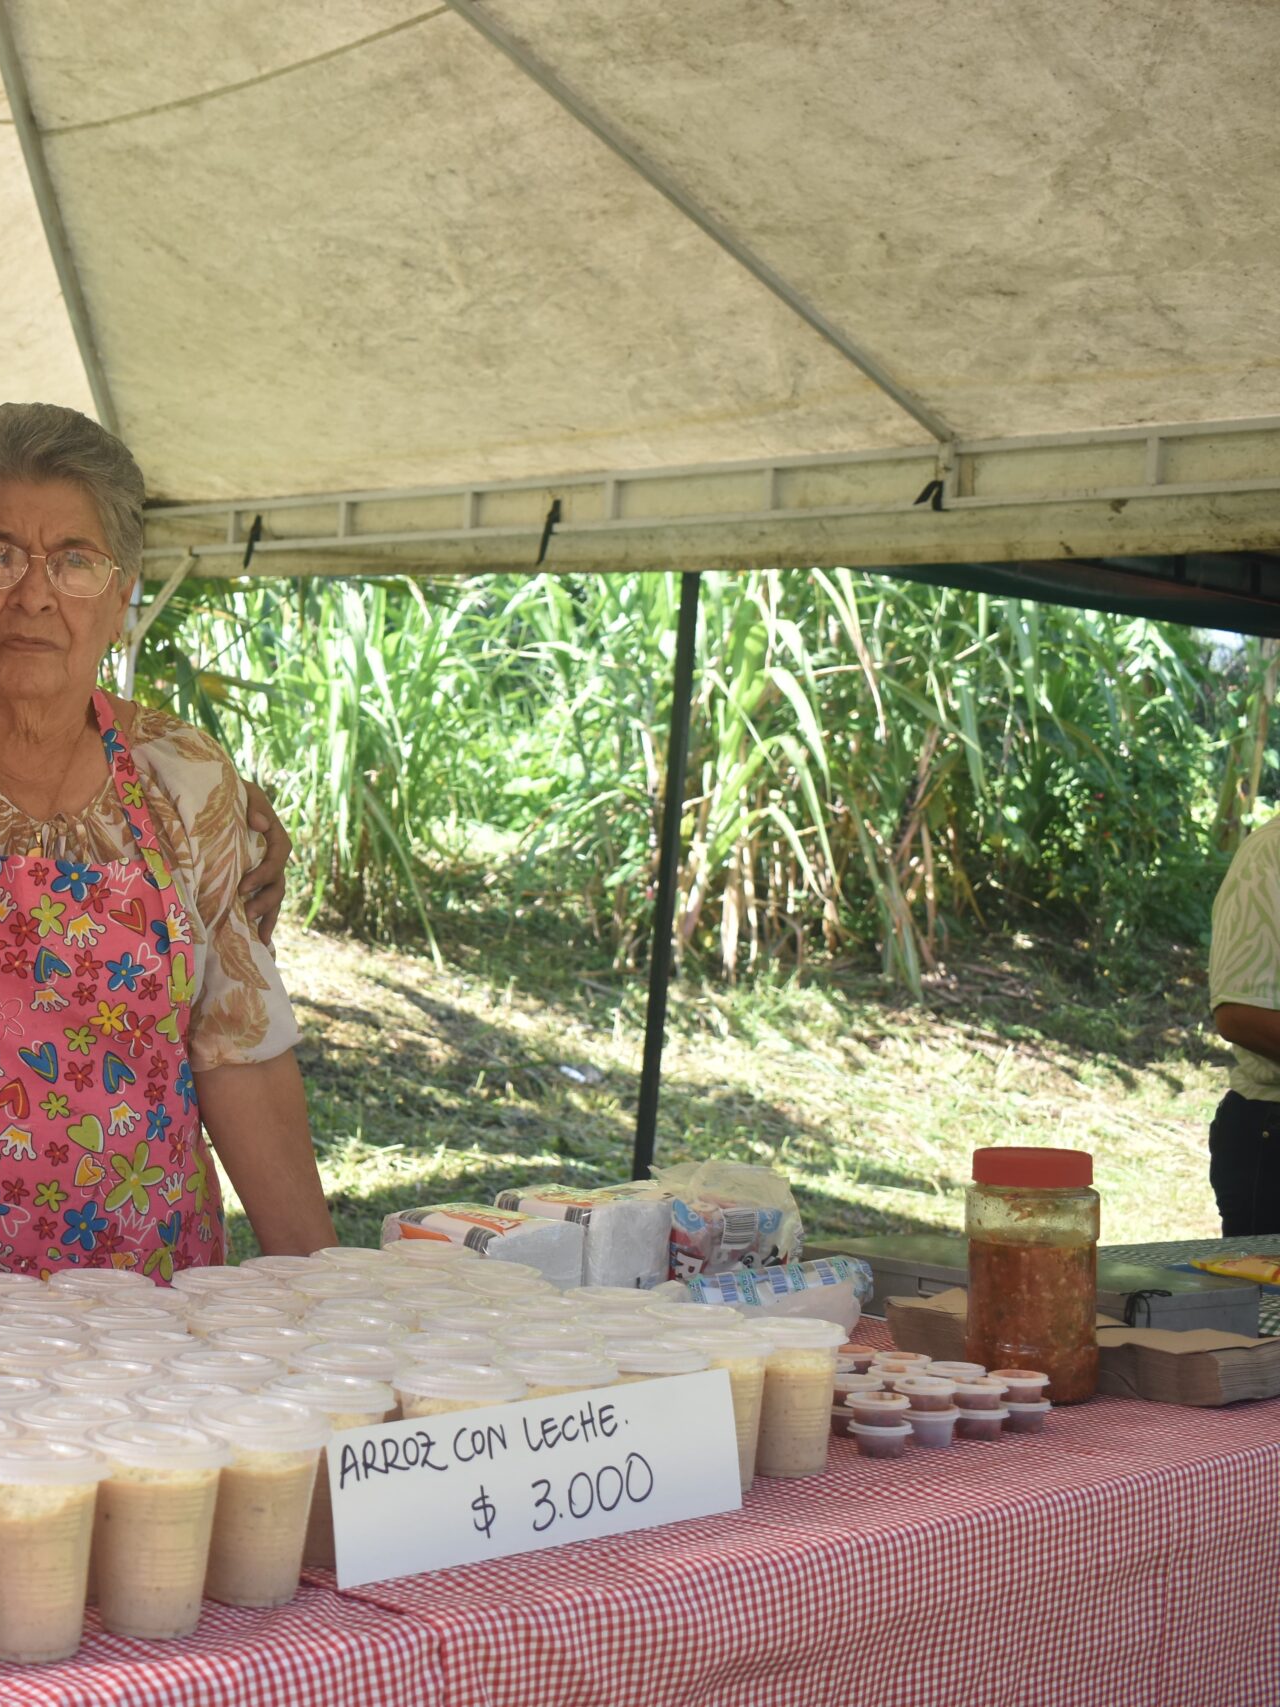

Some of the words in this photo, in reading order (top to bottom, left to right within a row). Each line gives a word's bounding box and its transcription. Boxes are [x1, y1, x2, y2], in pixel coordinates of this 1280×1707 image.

[339, 1431, 448, 1489] ARROZ
[453, 1424, 507, 1462] CON
[523, 1402, 629, 1451] LECHE.
[472, 1485, 497, 1538] $
[531, 1452, 654, 1531] 3.000
